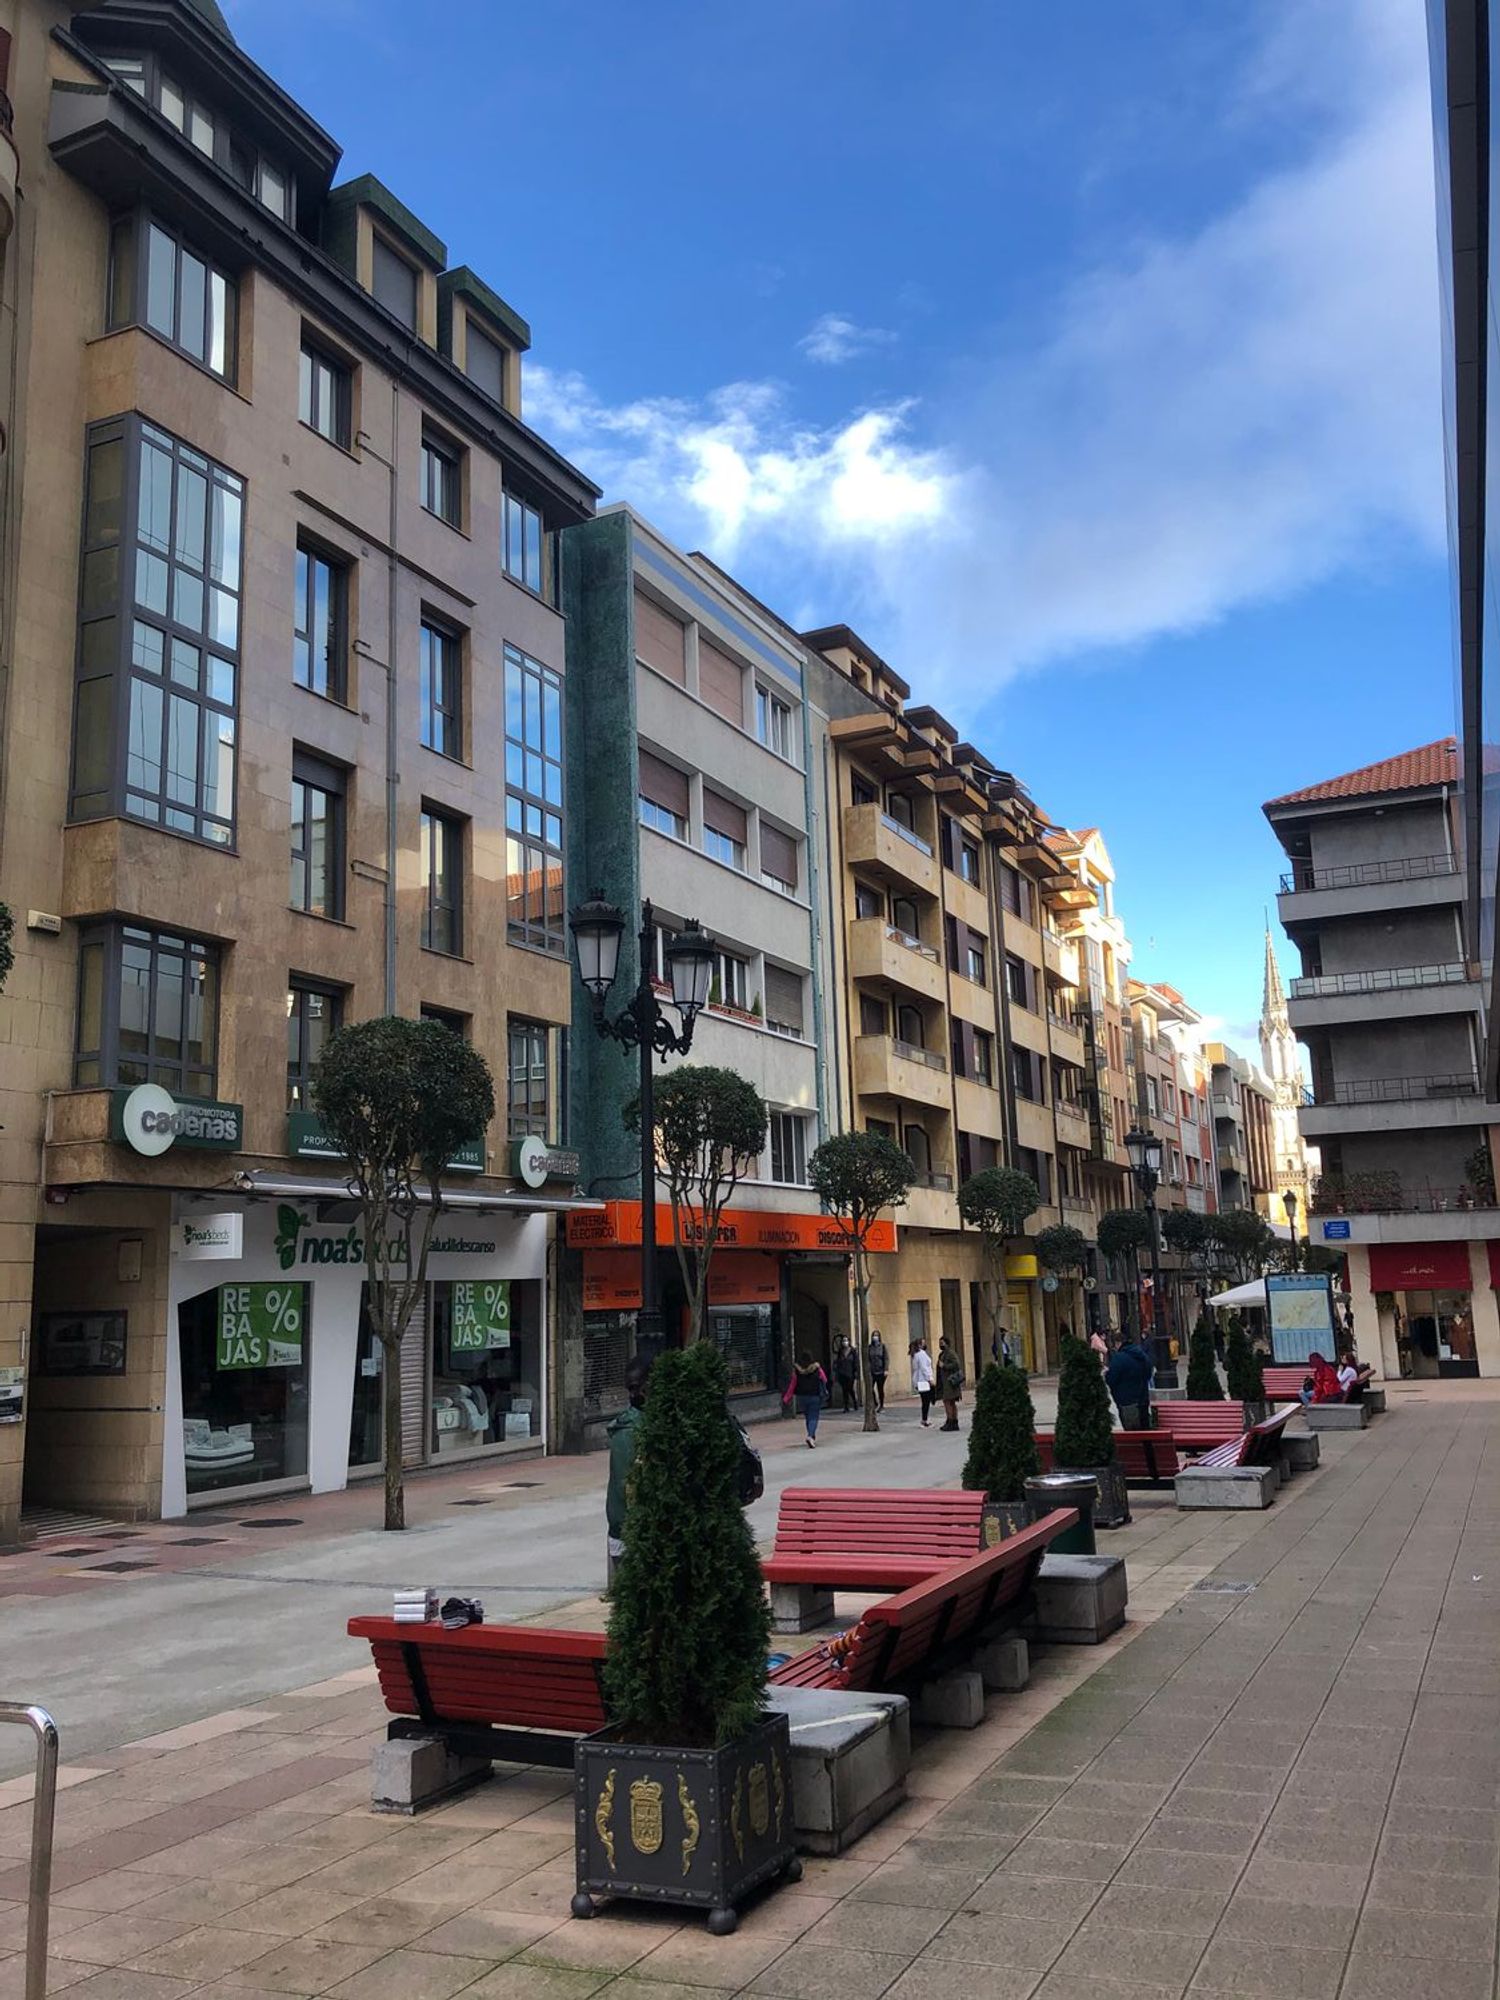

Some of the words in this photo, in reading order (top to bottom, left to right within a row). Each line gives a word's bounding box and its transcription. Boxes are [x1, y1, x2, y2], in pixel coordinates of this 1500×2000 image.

[573, 1213, 612, 1227] MATERIAL
[223, 1288, 251, 1313] RE
[455, 1283, 475, 1304] RE
[454, 1304, 477, 1325] BA
[222, 1313, 253, 1339] BA
[453, 1325, 483, 1347] JAS
[220, 1337, 262, 1366] JAS
